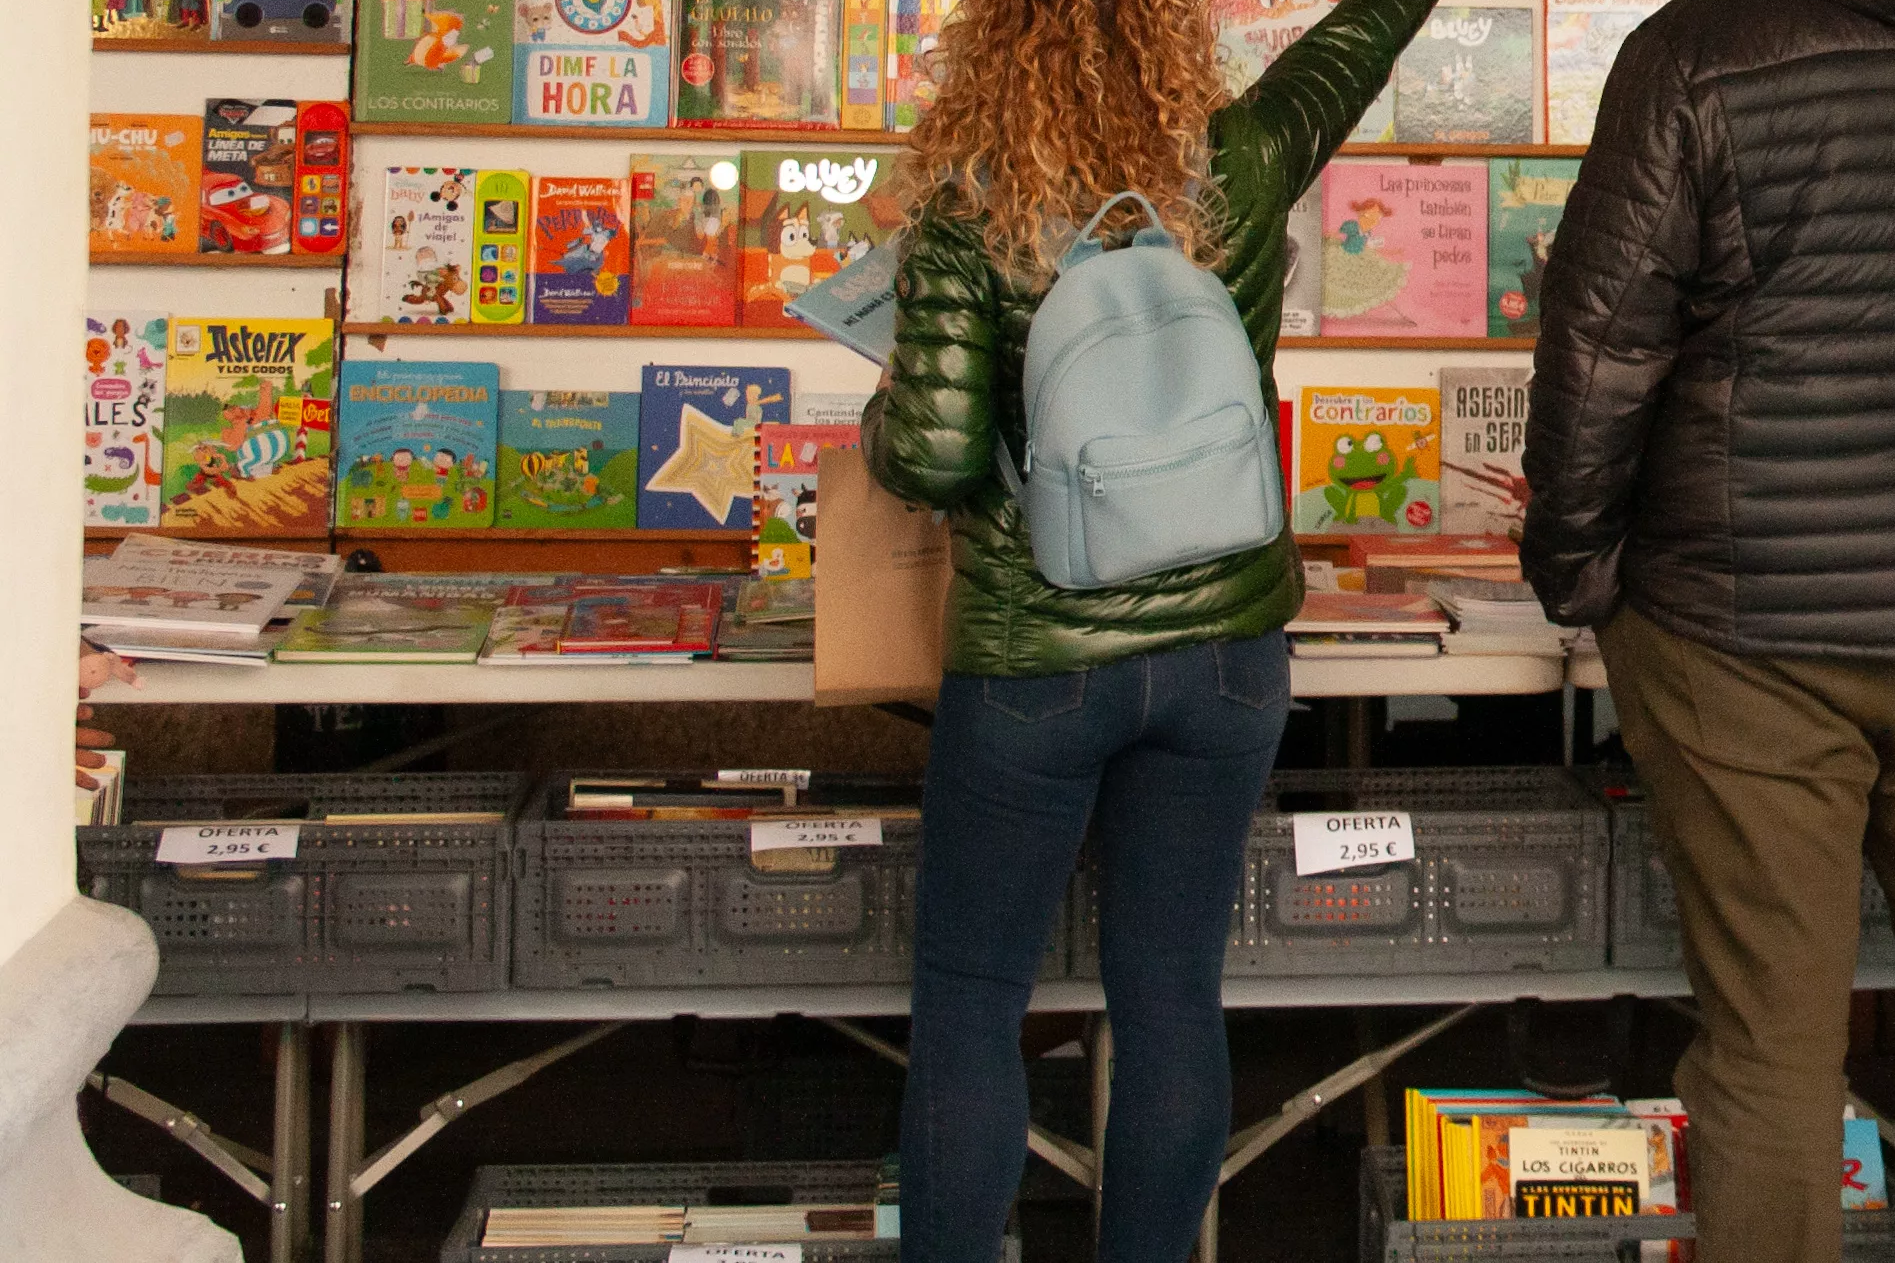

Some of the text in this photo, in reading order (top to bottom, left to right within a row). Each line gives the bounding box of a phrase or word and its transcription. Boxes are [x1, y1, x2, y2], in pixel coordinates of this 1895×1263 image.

[609, 55, 638, 77] LA
[368, 96, 499, 112] LOS CONTRARIOS
[542, 81, 638, 116] HORA
[209, 128, 249, 139] Amigos
[248, 140, 267, 151] DE
[207, 150, 247, 162] META
[1380, 174, 1472, 197] Las princesas
[390, 189, 425, 203] baby
[1420, 198, 1472, 217] también
[434, 221, 448, 231] de
[1421, 228, 1436, 239] se
[1433, 249, 1472, 270] pedos
[218, 365, 293, 374] Y LOS GODOS
[656, 371, 740, 389] El Principito
[350, 384, 489, 403] ENCICLOPEDIA
[1457, 386, 1526, 419] ASESIN
[1313, 400, 1429, 423] contrarios
[768, 443, 795, 469] LA
[785, 820, 863, 830] OFERTA
[1326, 816, 1401, 832] OFERTA
[199, 827, 279, 838] OFERTA
[845, 833, 857, 842] €
[207, 842, 270, 856] 2,95 €
[1340, 841, 1397, 861] 2,95 €
[1559, 1146, 1600, 1156] TINTIN
[1522, 1160, 1638, 1175] LOS CIGARROS
[1523, 1195, 1633, 1217] TINTIN
